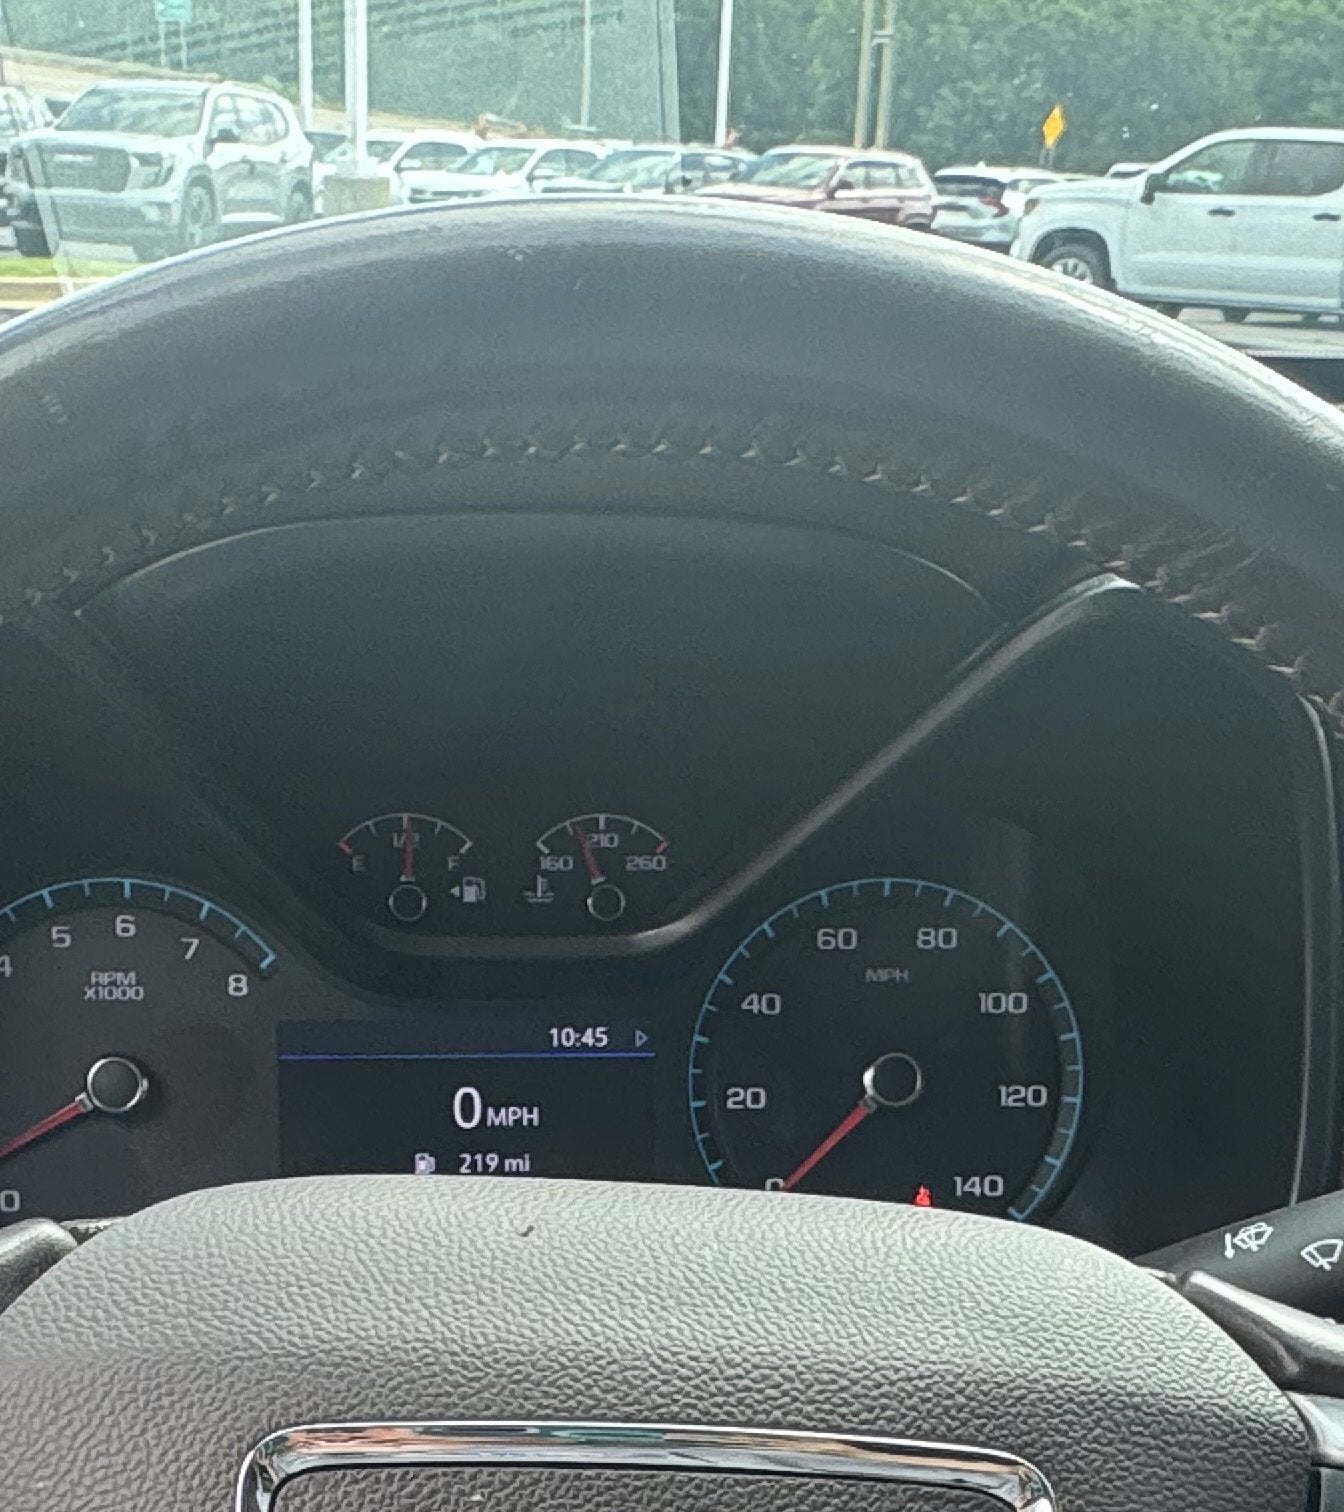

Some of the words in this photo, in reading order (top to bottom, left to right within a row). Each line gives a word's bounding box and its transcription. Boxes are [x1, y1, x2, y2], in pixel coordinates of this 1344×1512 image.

[585, 832, 619, 848] 210
[352, 854, 366, 871] E
[447, 856, 461, 871] F
[540, 855, 573, 871] 160
[625, 855, 667, 871] 260
[115, 915, 137, 937] 6
[51, 927, 72, 948] 5
[180, 937, 201, 960] 7
[816, 928, 857, 950] 60
[916, 927, 957, 950] 80
[90, 971, 137, 985] RPM
[227, 974, 249, 997] 8
[866, 968, 909, 983] MPH
[740, 993, 782, 1016] 40
[978, 992, 1028, 1014] 100
[549, 1027, 609, 1049] 10:45
[725, 1087, 766, 1110] 20
[999, 1085, 1048, 1108] 120
[452, 1086, 483, 1130] 0
[487, 1106, 539, 1127] MPH
[458, 1153, 499, 1174] 219
[504, 1152, 531, 1173] mi
[953, 1175, 1004, 1197] 140
